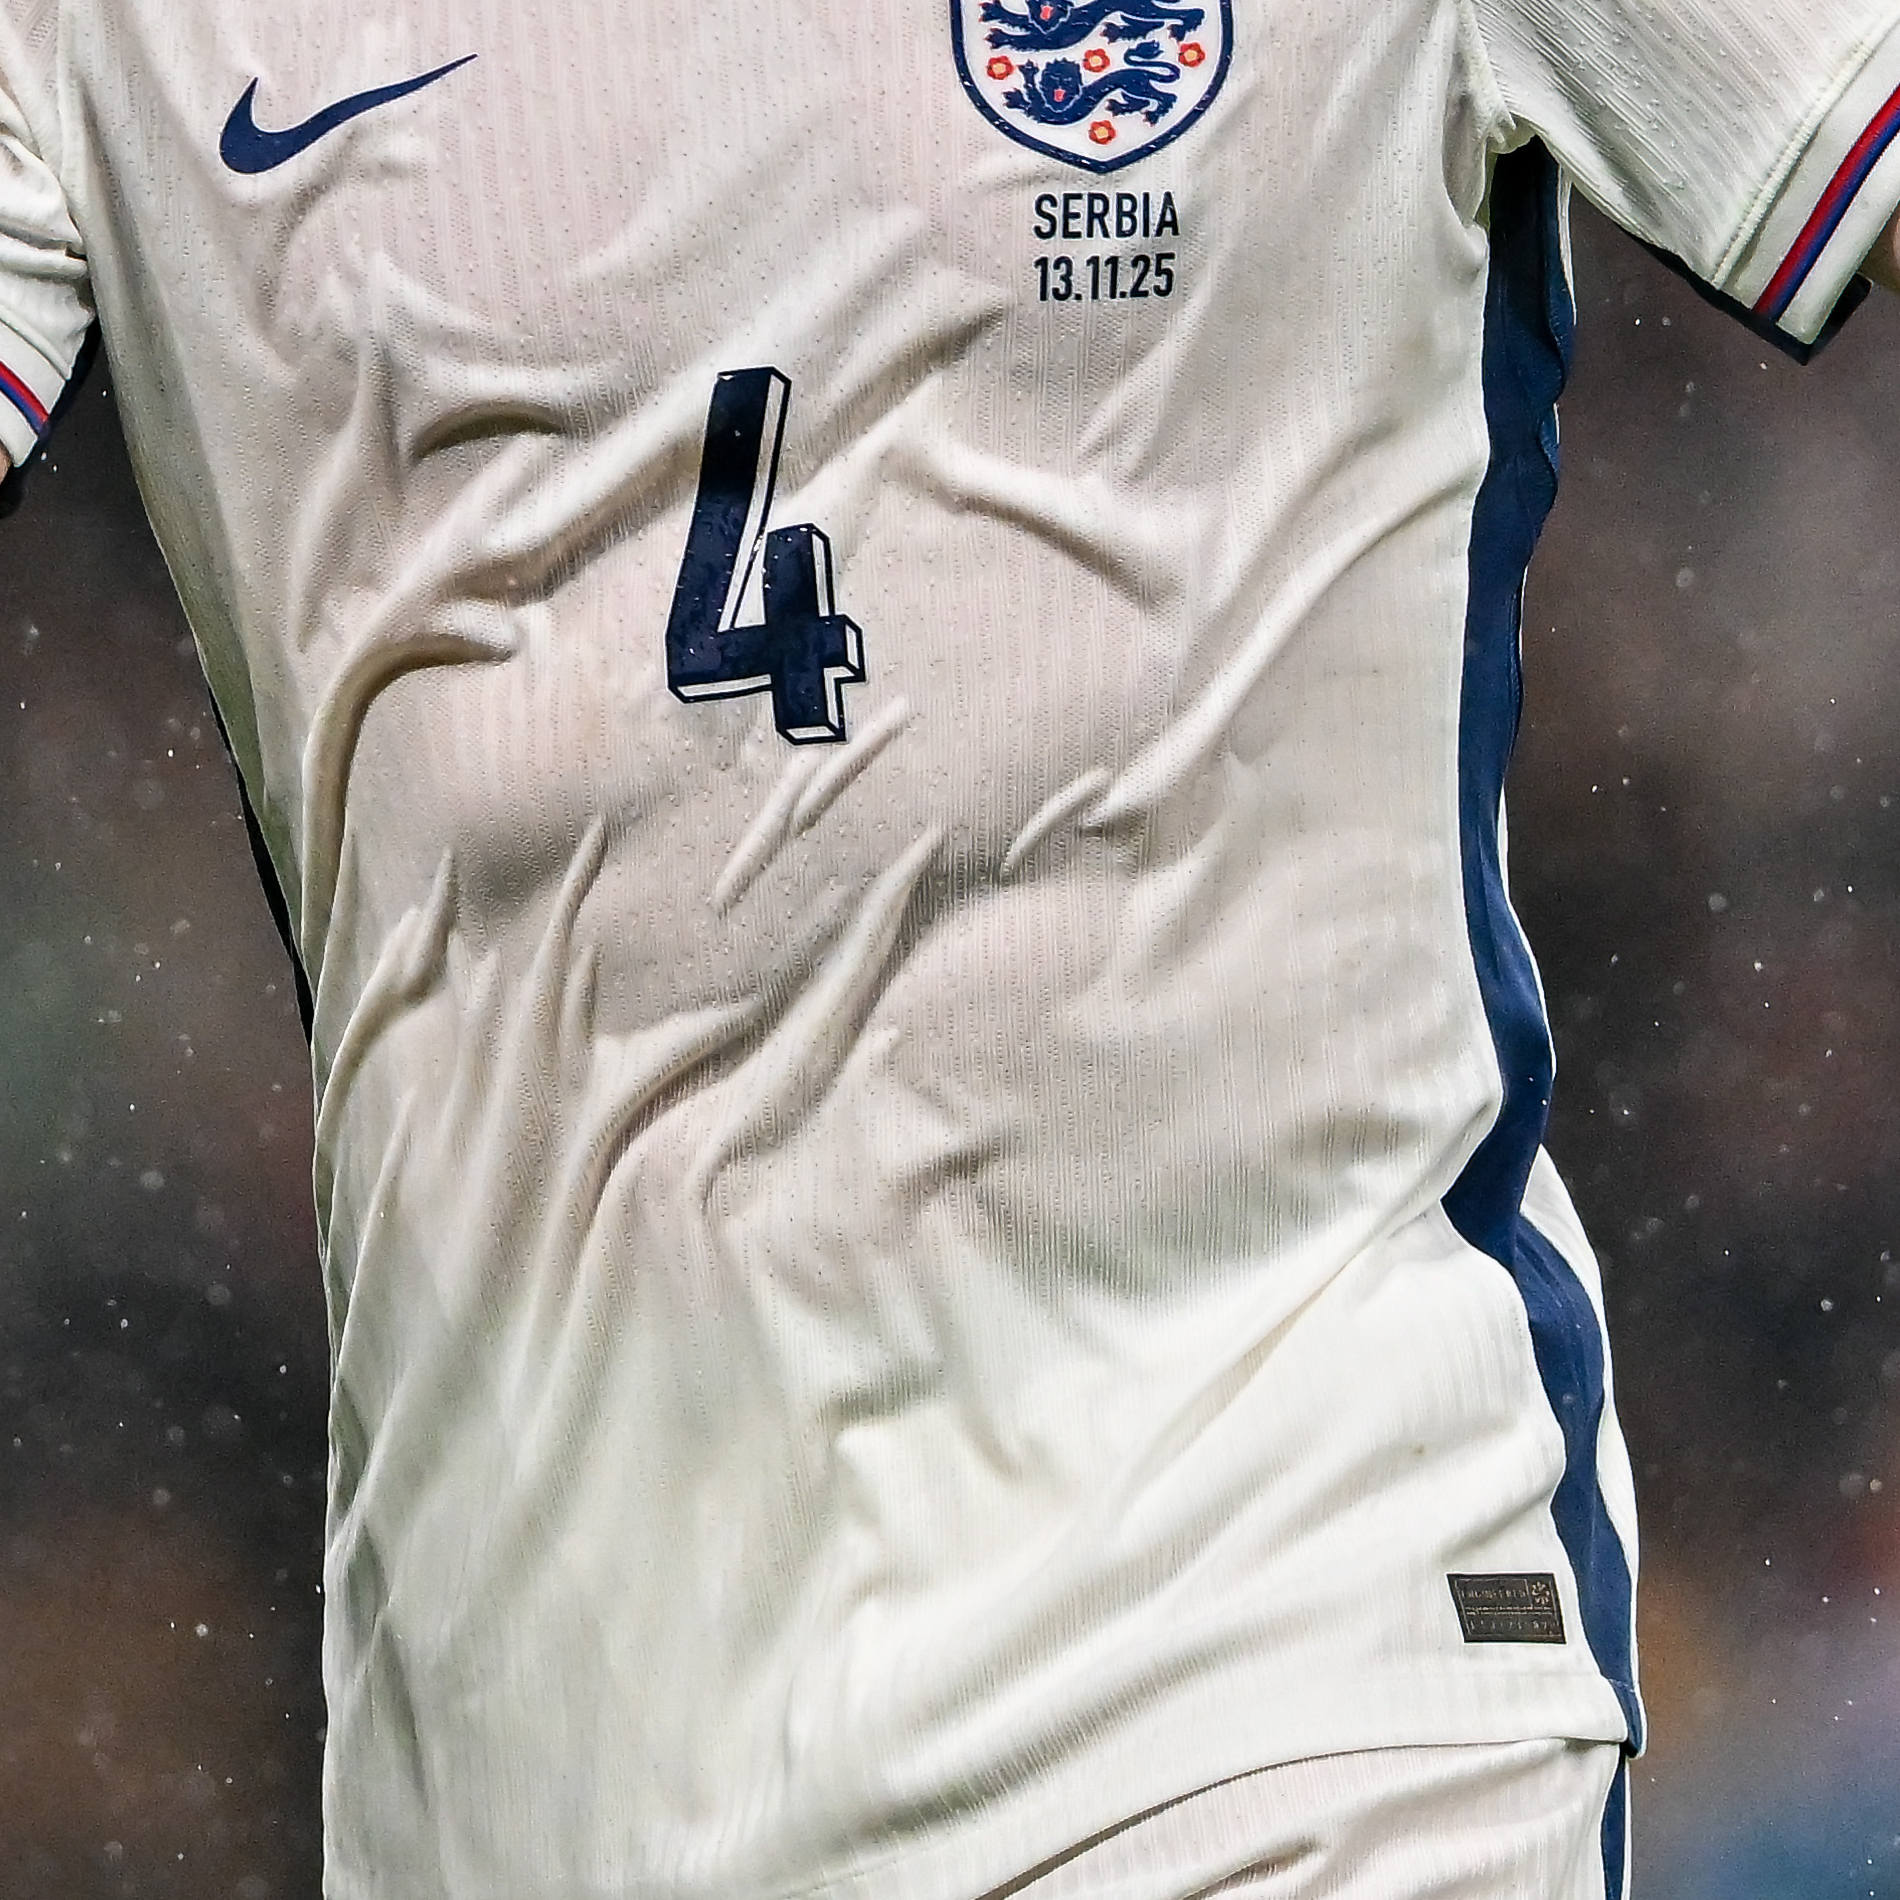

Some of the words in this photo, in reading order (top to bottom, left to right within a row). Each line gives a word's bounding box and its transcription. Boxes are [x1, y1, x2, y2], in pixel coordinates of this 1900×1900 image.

[1033, 191, 1181, 240] SERBIA
[1034, 253, 1176, 302] 13.11.25
[665, 366, 868, 745] 4
